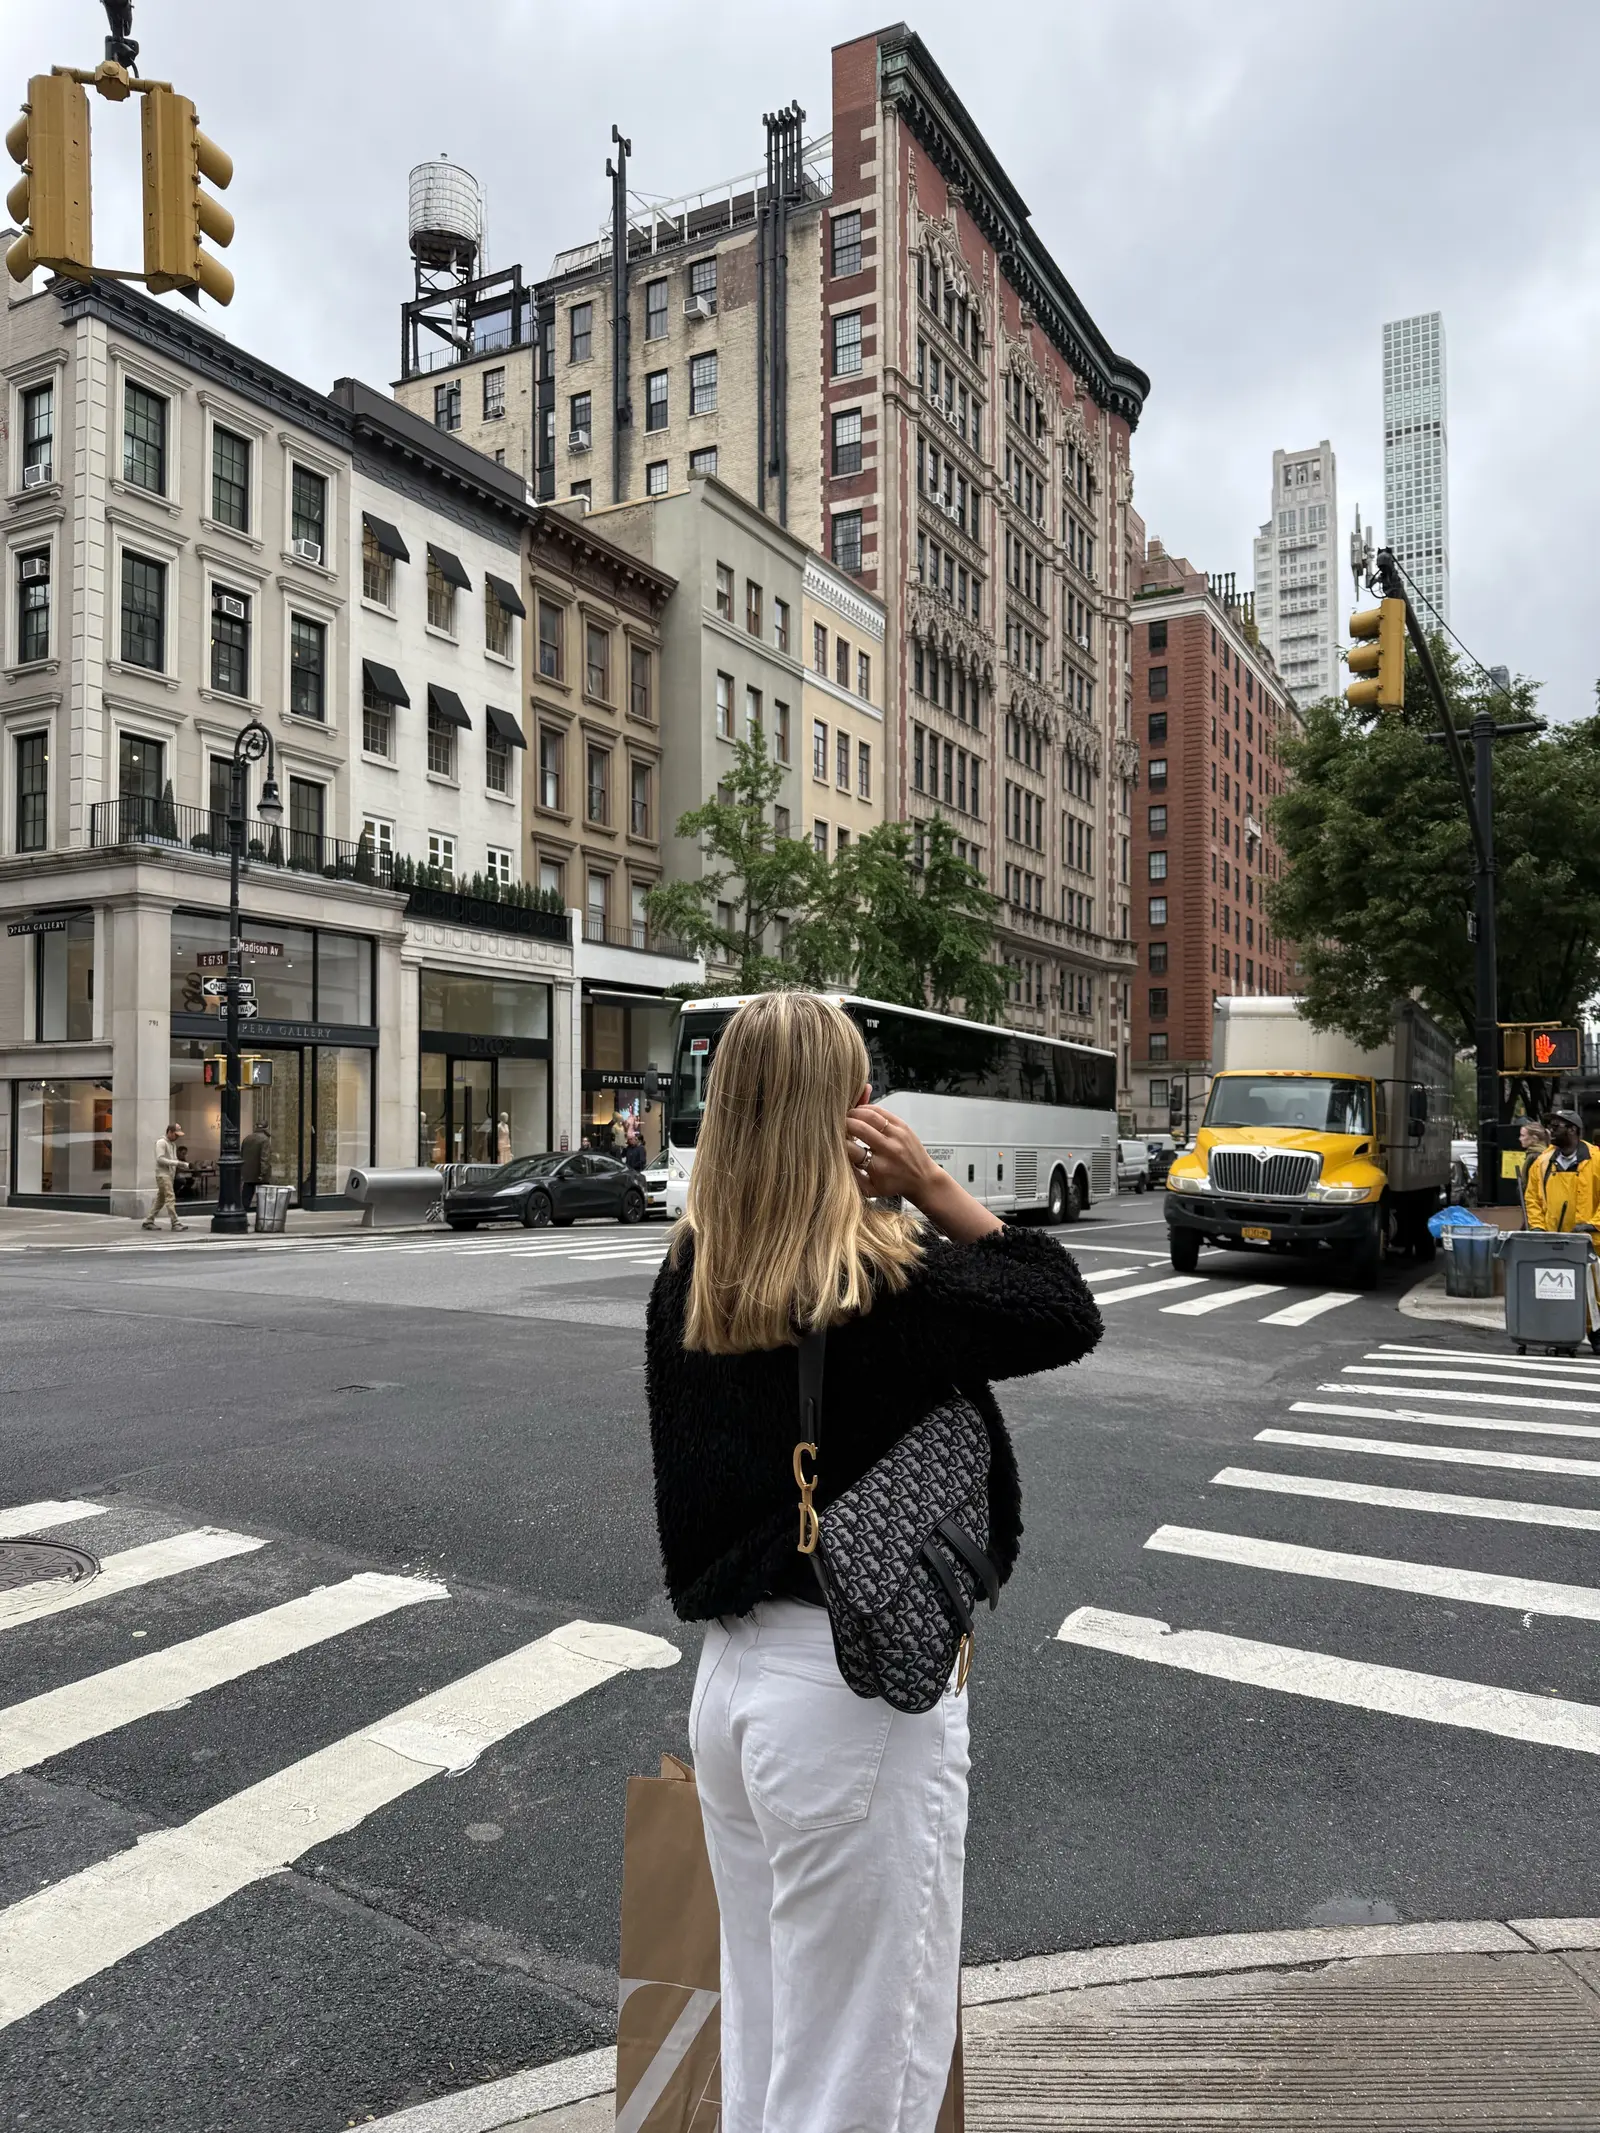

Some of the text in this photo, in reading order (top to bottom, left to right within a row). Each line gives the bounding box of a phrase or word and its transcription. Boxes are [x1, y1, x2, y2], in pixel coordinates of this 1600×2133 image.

[33, 921, 65, 931] GALLERY
[240, 942, 279, 956] Madison Av
[203, 954, 223, 966] E 67 St
[209, 982, 250, 992] ONE AY
[240, 1006, 252, 1014] WAY
[237, 1023, 332, 1038] PERA GALLERY
[602, 1075, 643, 1085] FRATELLI
